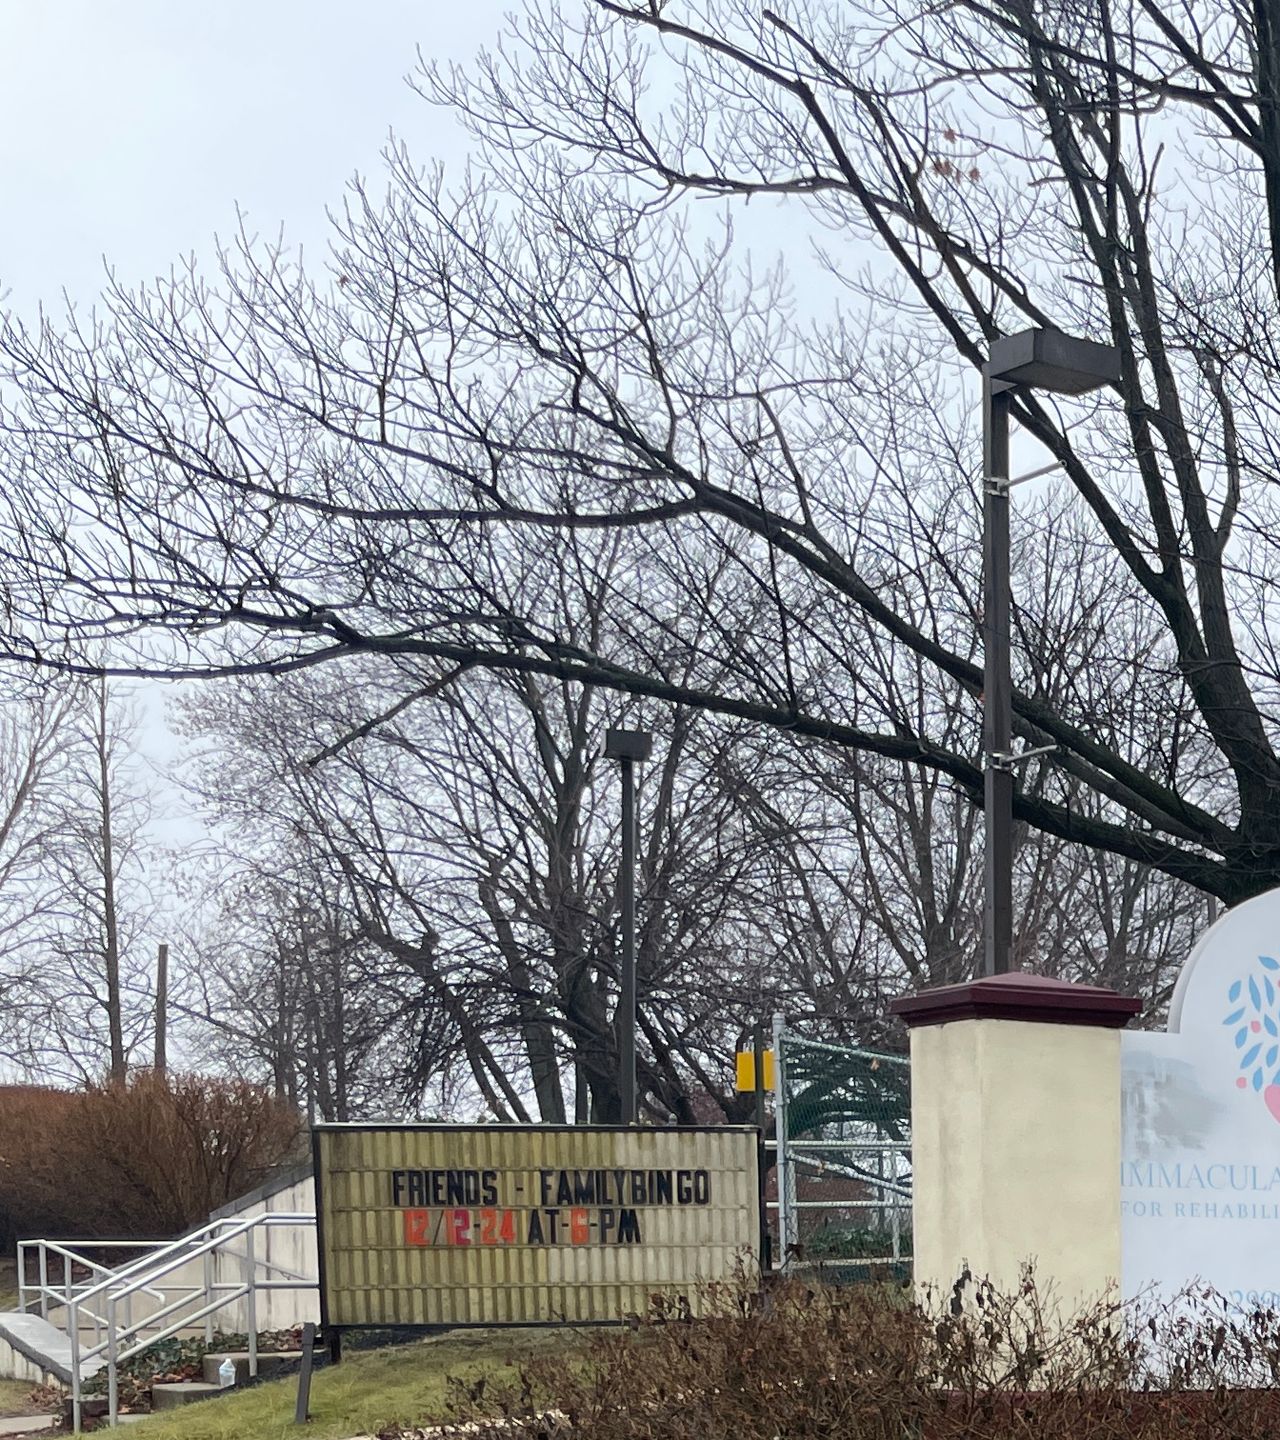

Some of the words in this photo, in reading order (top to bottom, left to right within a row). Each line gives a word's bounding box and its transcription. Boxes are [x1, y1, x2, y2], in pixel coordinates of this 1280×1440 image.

[392, 1169, 498, 1206] FRIENDS
[540, 1169, 711, 1206] FAMILYBINGO
[404, 1207, 516, 1246] 12/12-24
[1119, 1200, 1163, 1218] FOR
